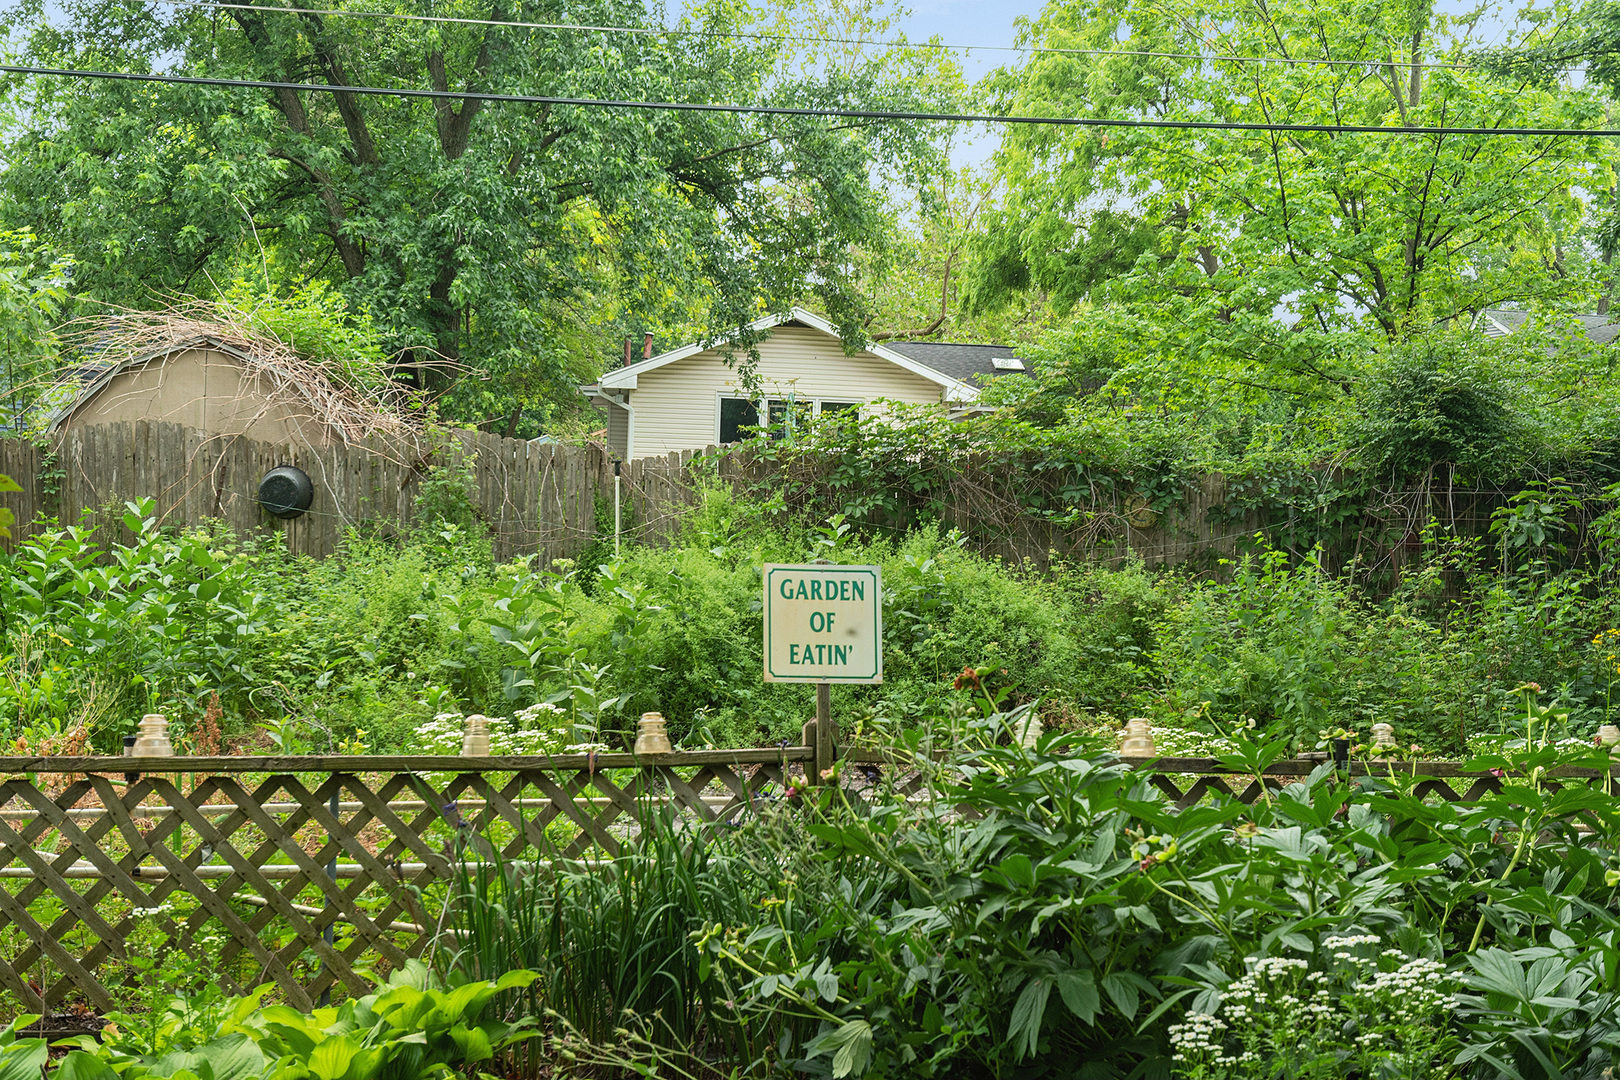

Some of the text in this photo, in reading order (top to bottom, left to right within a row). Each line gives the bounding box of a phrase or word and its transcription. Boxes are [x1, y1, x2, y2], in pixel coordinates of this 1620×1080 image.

[780, 579, 864, 601] GARDEN
[809, 611, 836, 633] OF
[789, 644, 853, 665] EATIN'
